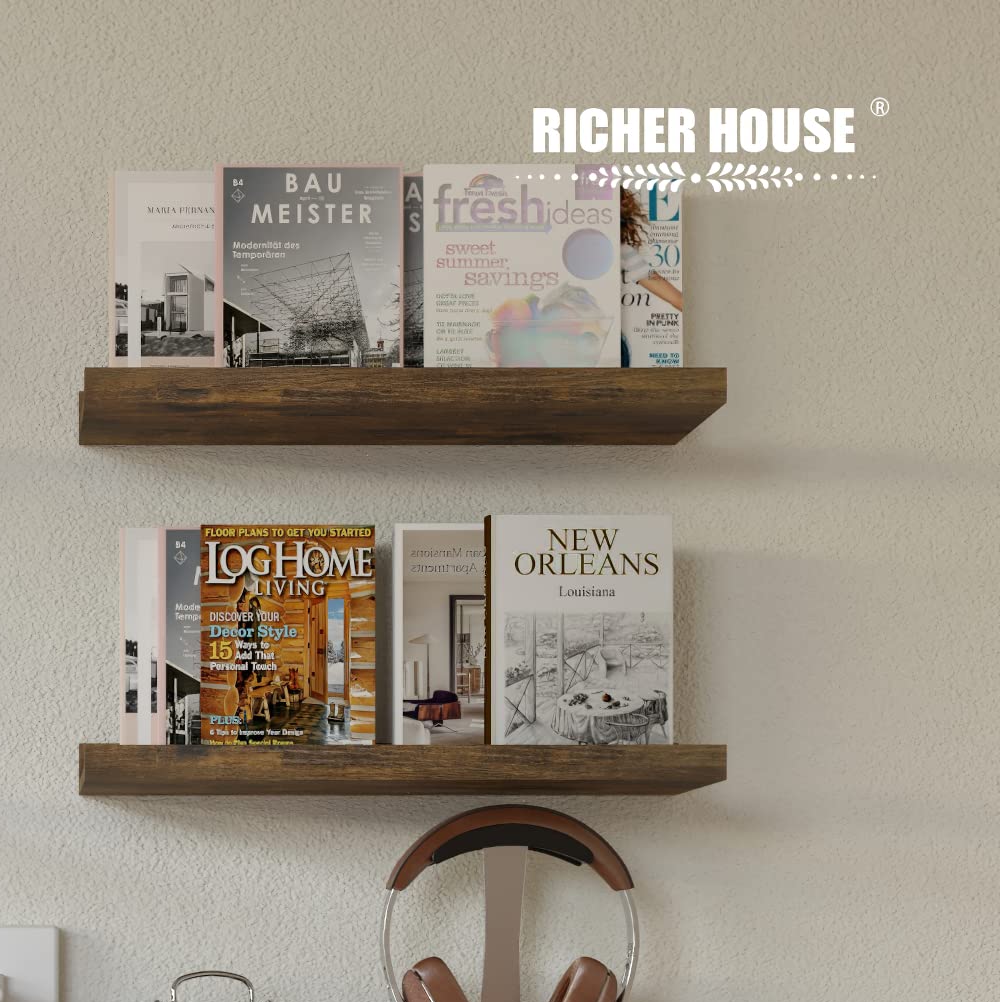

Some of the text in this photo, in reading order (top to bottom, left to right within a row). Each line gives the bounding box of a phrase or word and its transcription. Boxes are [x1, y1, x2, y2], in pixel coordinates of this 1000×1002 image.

[285, 172, 343, 193] BAU
[433, 183, 613, 225] fresh ideas
[251, 203, 373, 225] MEISTER
[445, 240, 497, 256] sweet
[648, 244, 680, 268] 30
[436, 256, 508, 270] summer
[463, 268, 560, 291] savings
[205, 528, 372, 537] FLOOR PLANS TO GET YOU STARTED
[546, 528, 620, 551] NEW
[513, 552, 661, 576] ORLEANS
[255, 580, 326, 596] LIVING
[558, 585, 616, 598] Louisiana
[175, 612, 201, 621] Temp
[209, 612, 280, 622] DISCOVER YOUR
[209, 625, 254, 638] Decor
[257, 625, 297, 641] Style
[209, 641, 233, 661] 15
[235, 640, 257, 650] Ways
[259, 641, 270, 649] to
[235, 651, 275, 660] Add That
[209, 662, 277, 671] Personal Touch
[209, 716, 243, 725] PLUS:
